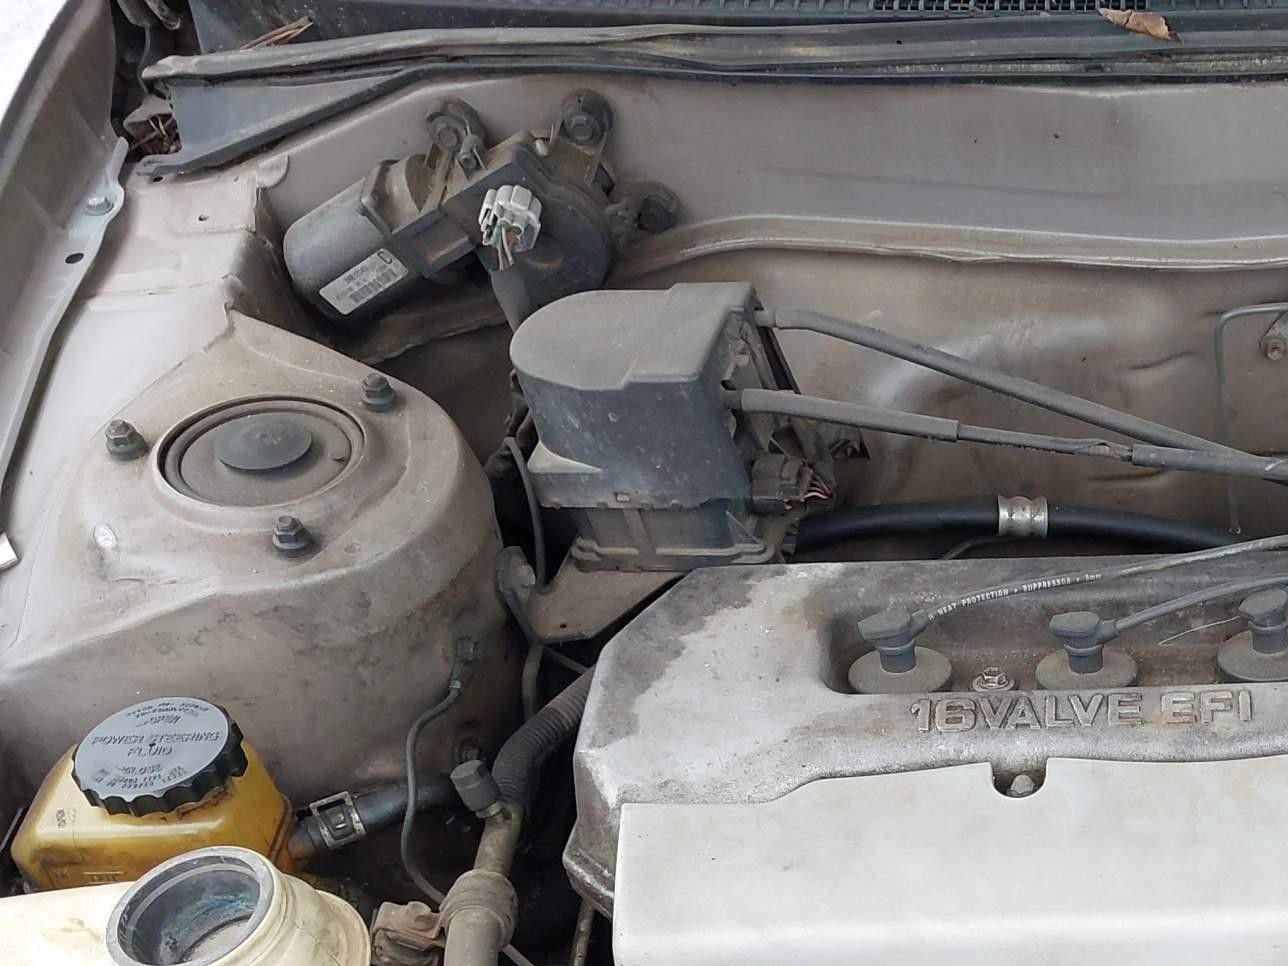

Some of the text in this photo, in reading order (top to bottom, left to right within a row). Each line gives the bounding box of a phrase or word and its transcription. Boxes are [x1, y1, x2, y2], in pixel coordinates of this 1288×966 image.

[961, 588, 1009, 607] PROTECTION
[1022, 577, 1071, 593] SUPPRESSOR
[1160, 688, 1253, 725] EFI
[92, 731, 220, 746] POWER STEERING
[127, 745, 173, 757] FLUID
